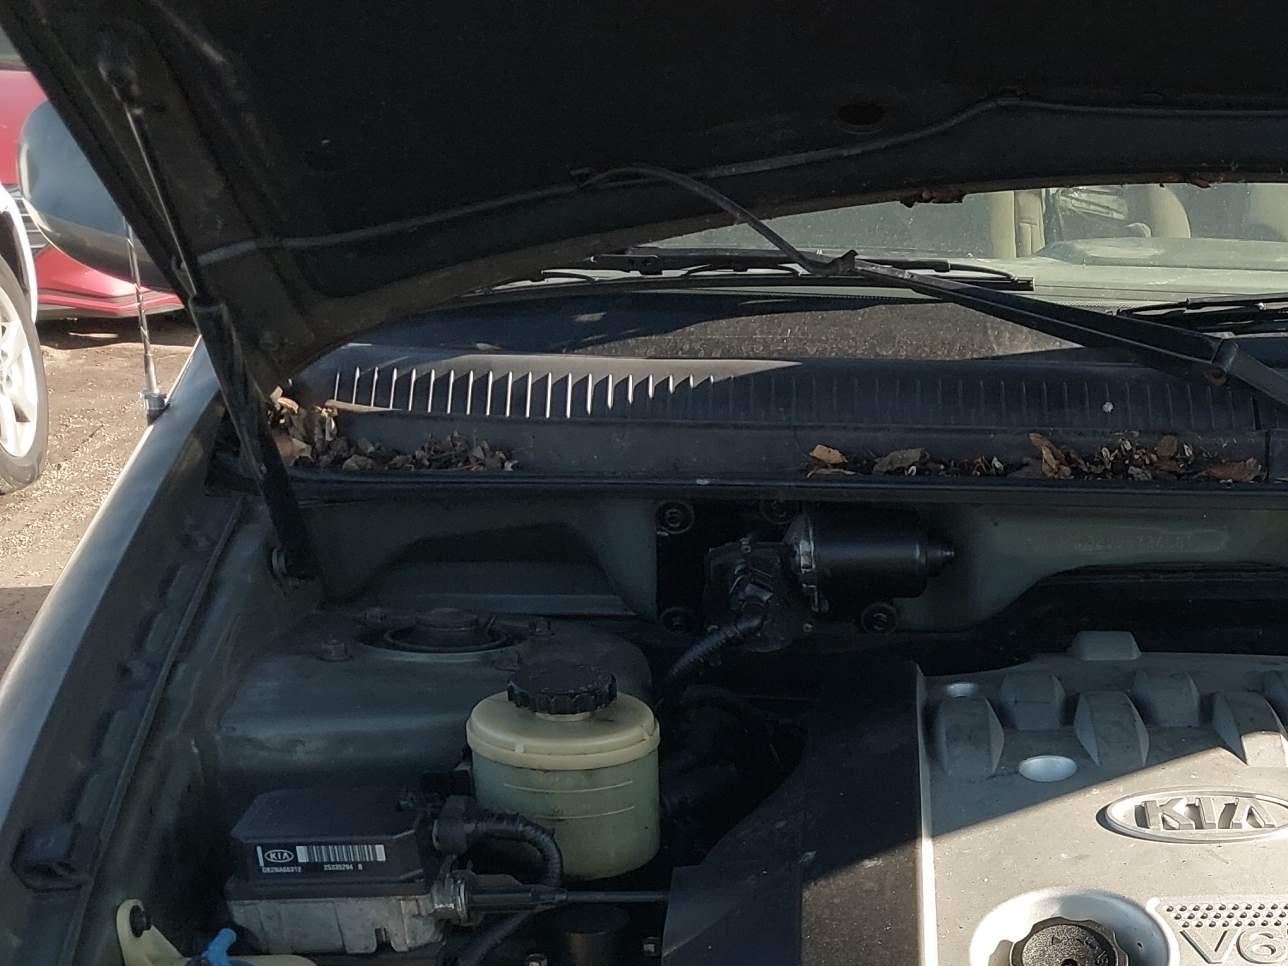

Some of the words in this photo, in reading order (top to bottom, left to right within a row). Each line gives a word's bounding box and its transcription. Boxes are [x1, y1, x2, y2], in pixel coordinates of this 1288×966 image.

[1134, 796, 1276, 831] KIA
[269, 851, 290, 860] KIA
[1179, 927, 1287, 964] V6
